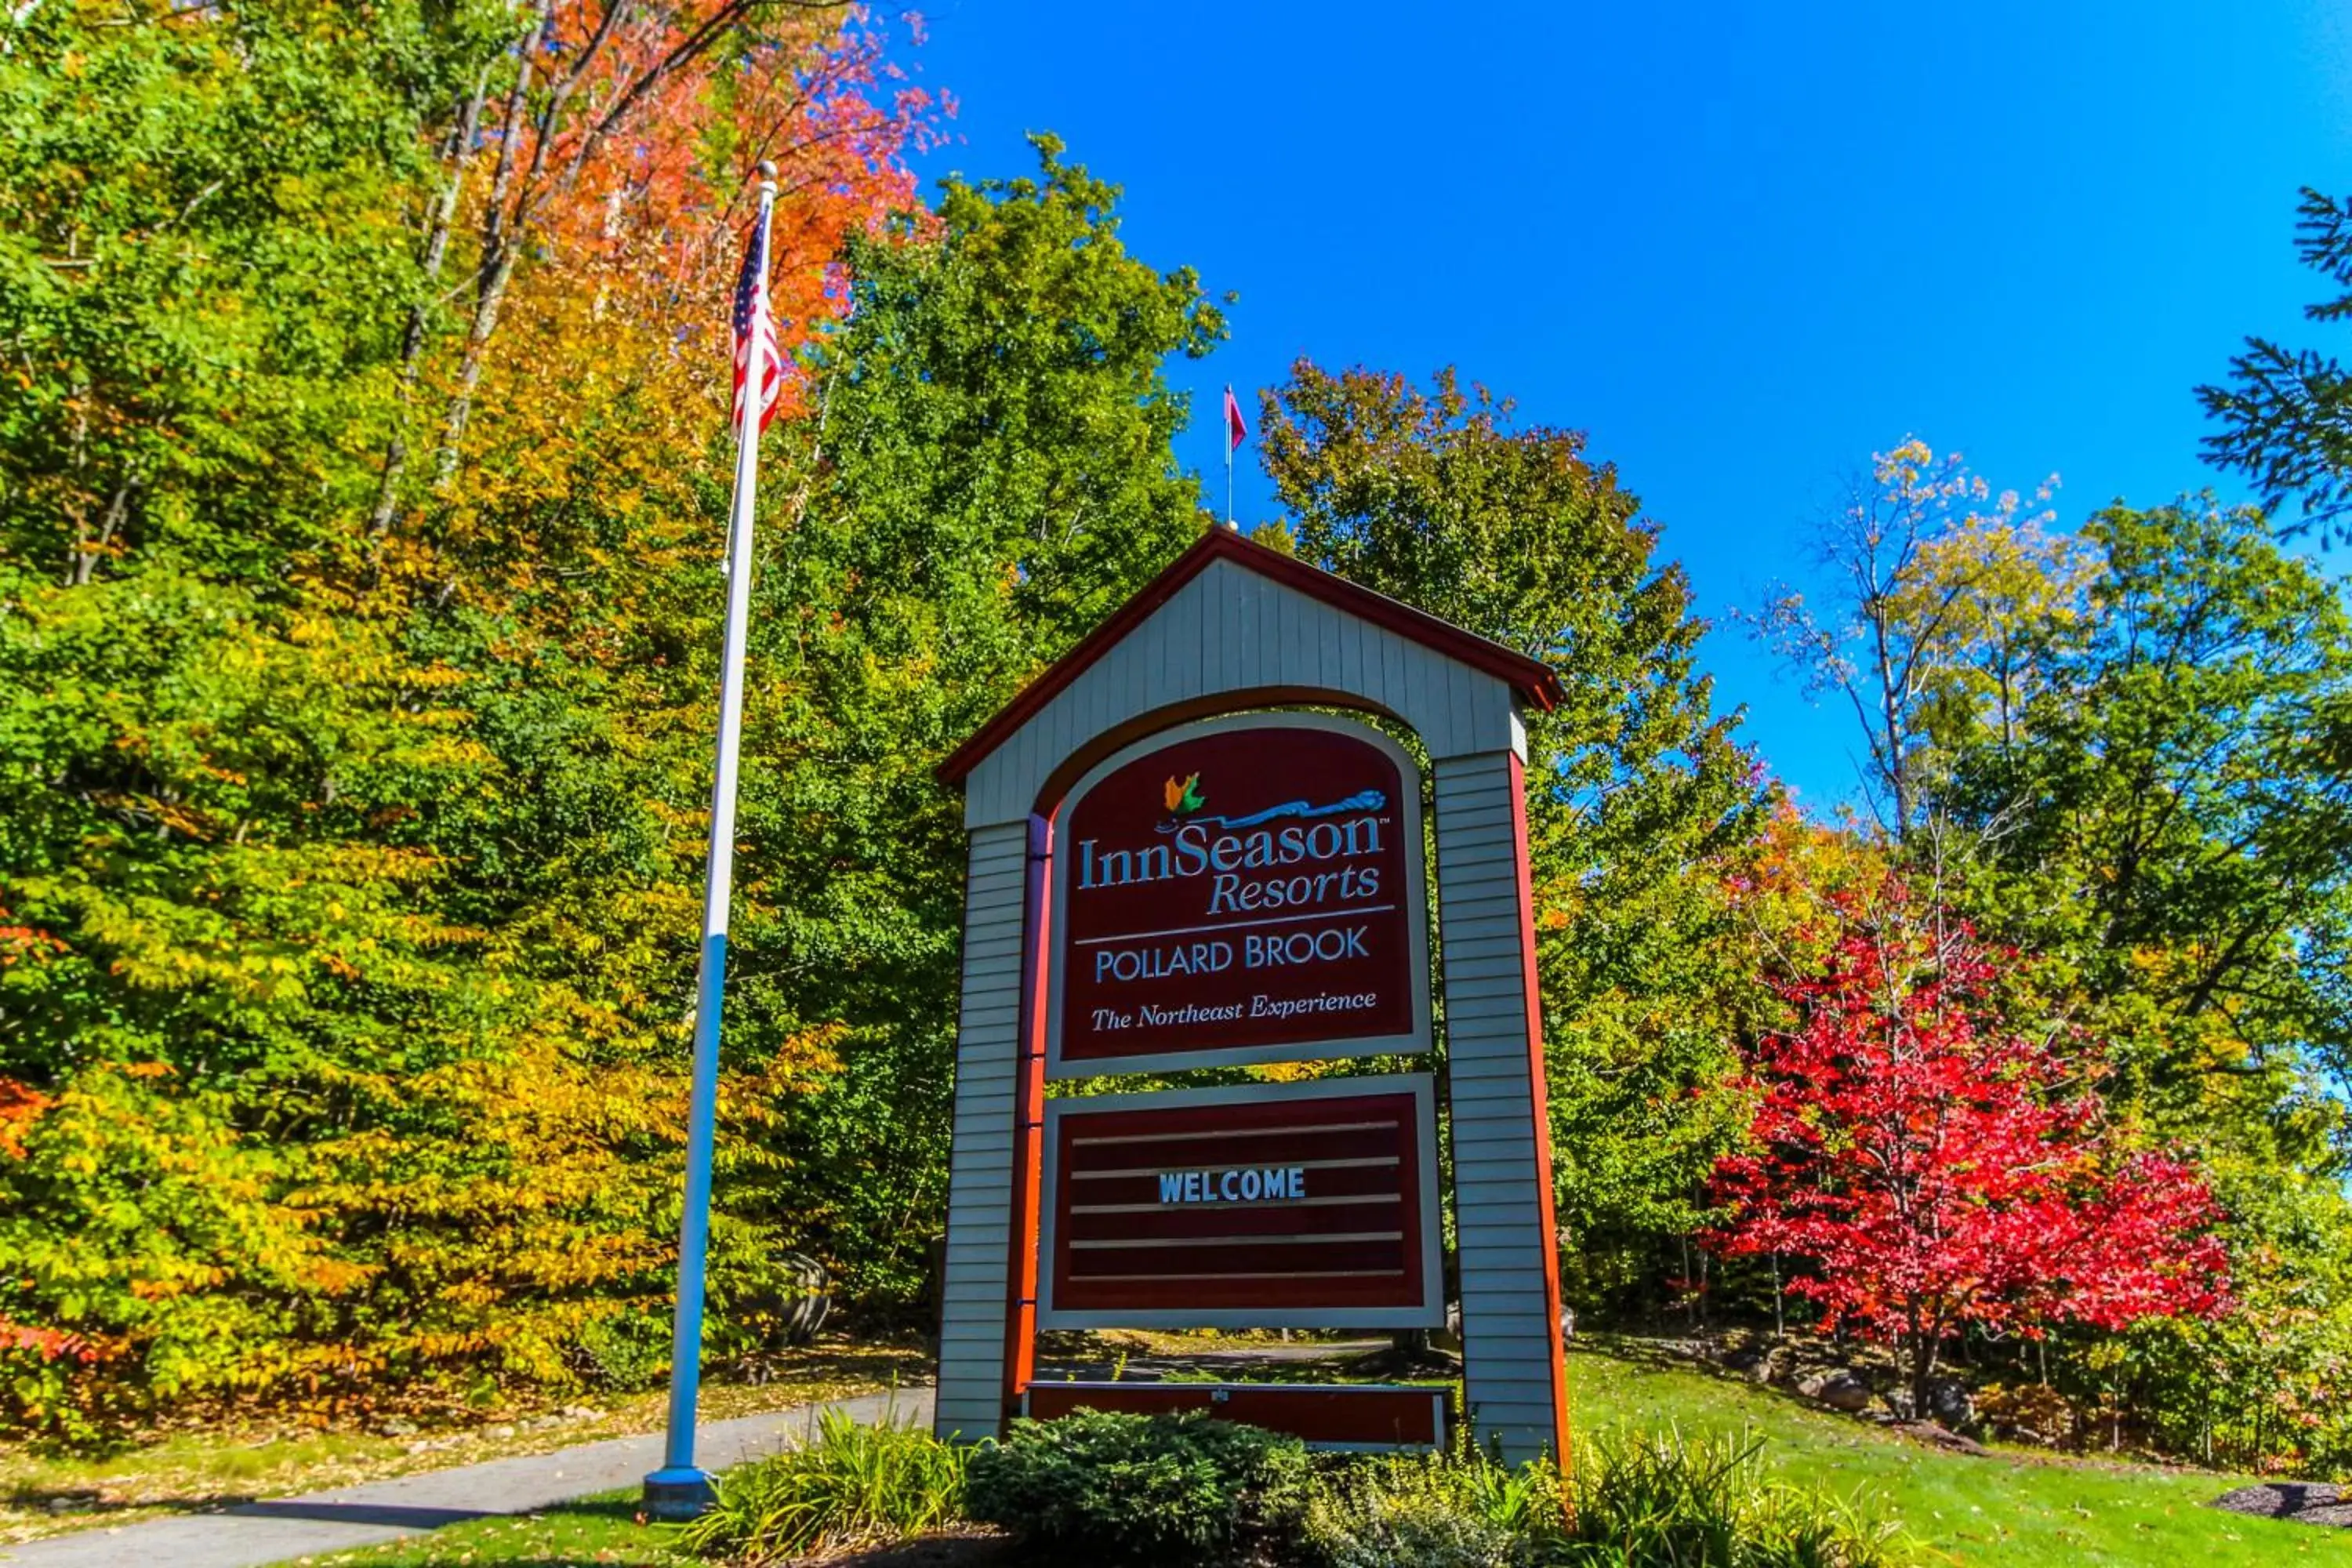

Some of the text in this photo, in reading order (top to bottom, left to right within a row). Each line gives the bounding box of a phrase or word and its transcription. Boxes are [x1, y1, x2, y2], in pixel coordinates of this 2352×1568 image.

[1207, 865, 1380, 914] Resorts
[1095, 927, 1369, 982] POLLARD BROOK
[1092, 991, 1377, 1031] The Northeast Experience
[1160, 1167, 1305, 1203] WELCOME
